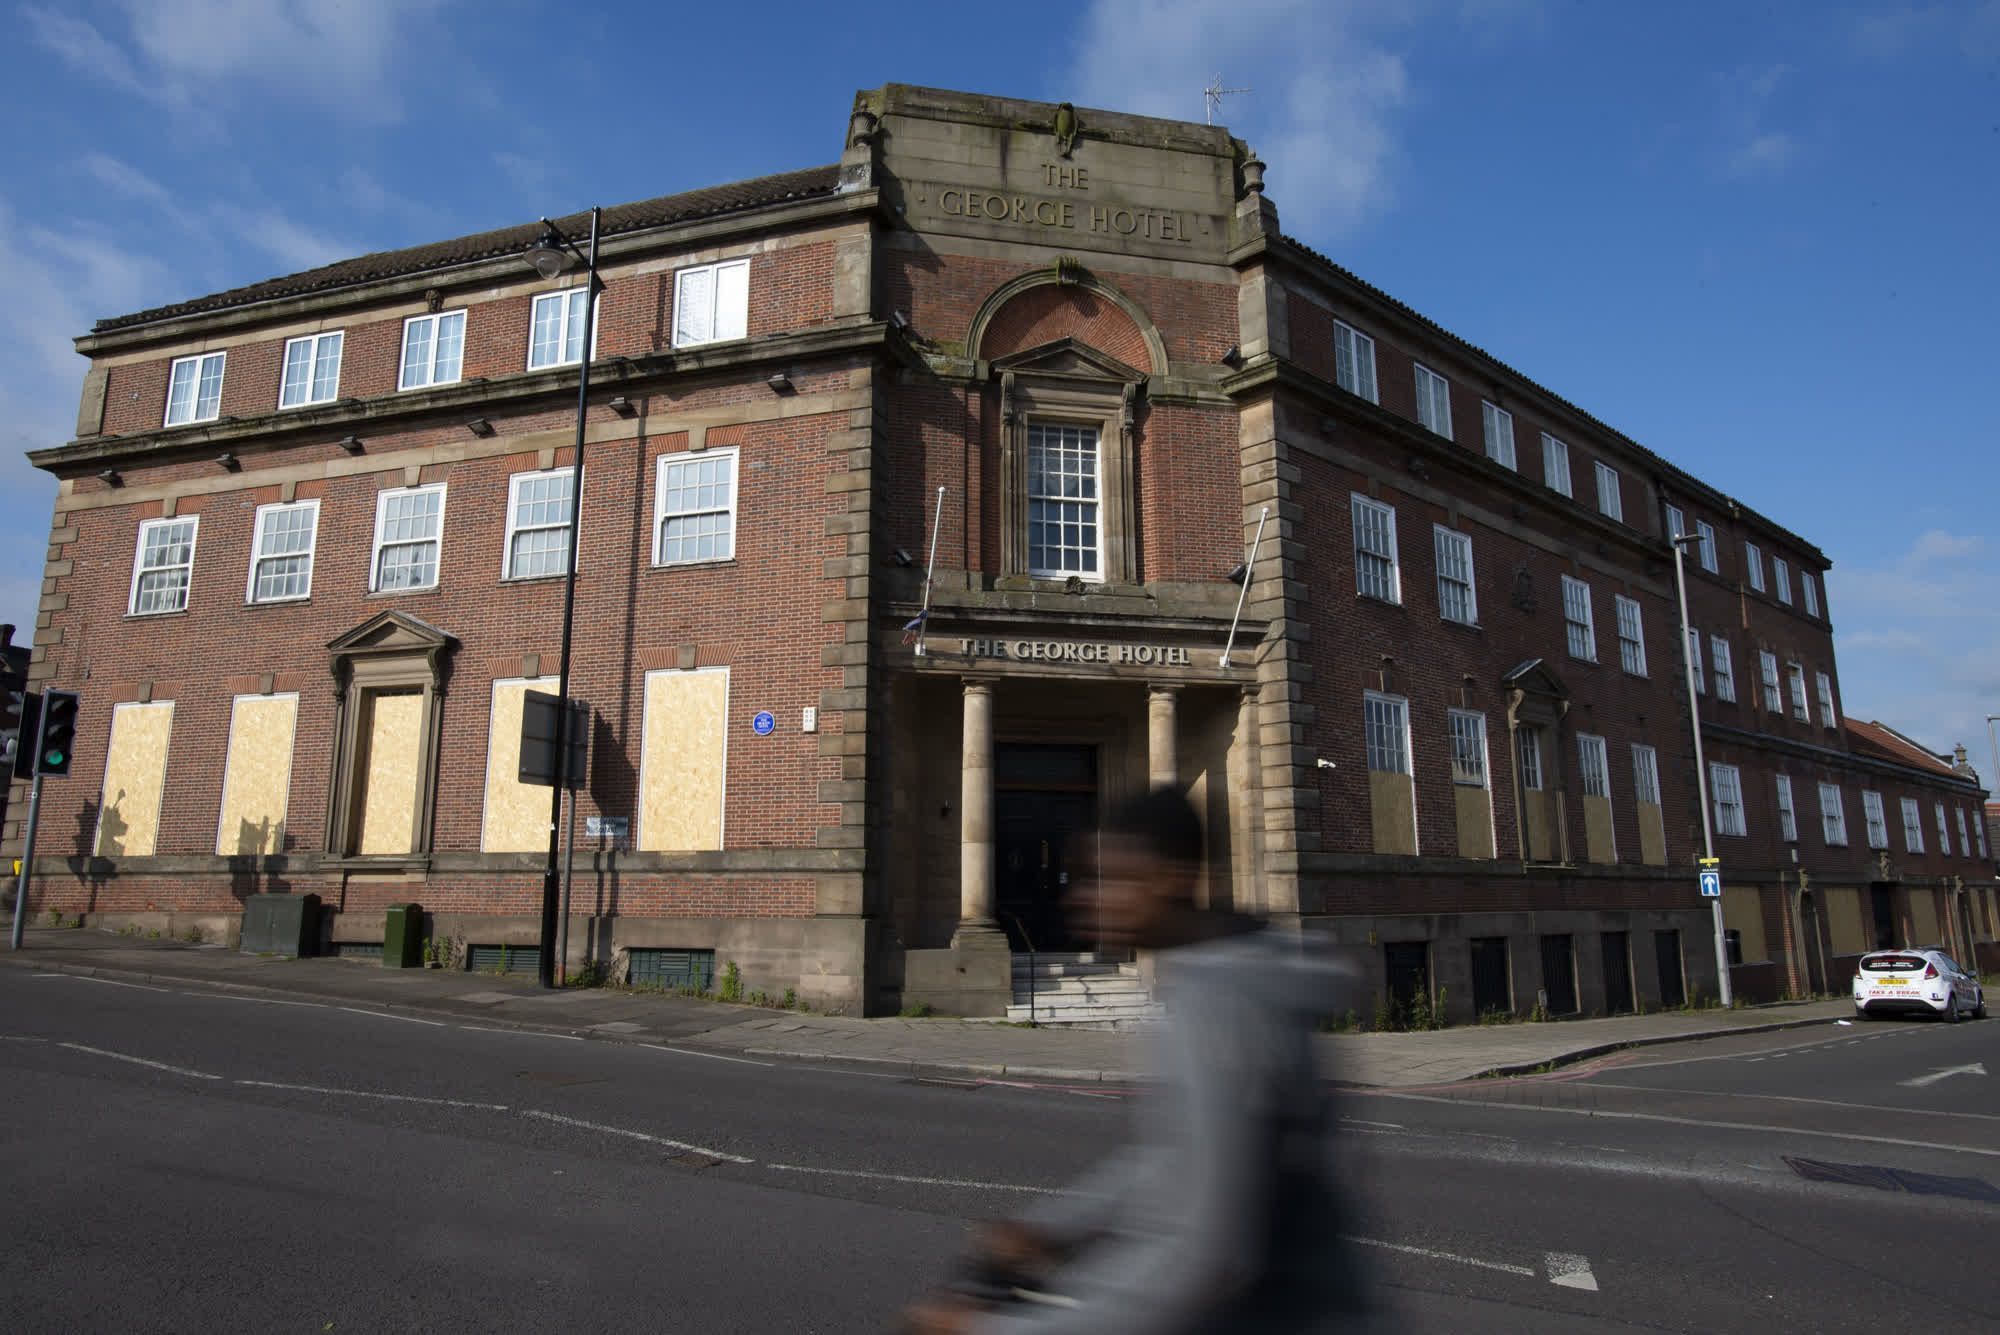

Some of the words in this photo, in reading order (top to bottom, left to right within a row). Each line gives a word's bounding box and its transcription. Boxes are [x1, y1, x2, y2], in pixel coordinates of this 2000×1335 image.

[1041, 163, 1089, 190] THE
[939, 190, 1075, 228] GEORGE
[1089, 207, 1192, 242] HOTEL
[959, 638, 1007, 657] THE
[1013, 640, 1110, 662] GEORGE
[1118, 644, 1192, 666] HOTEL
